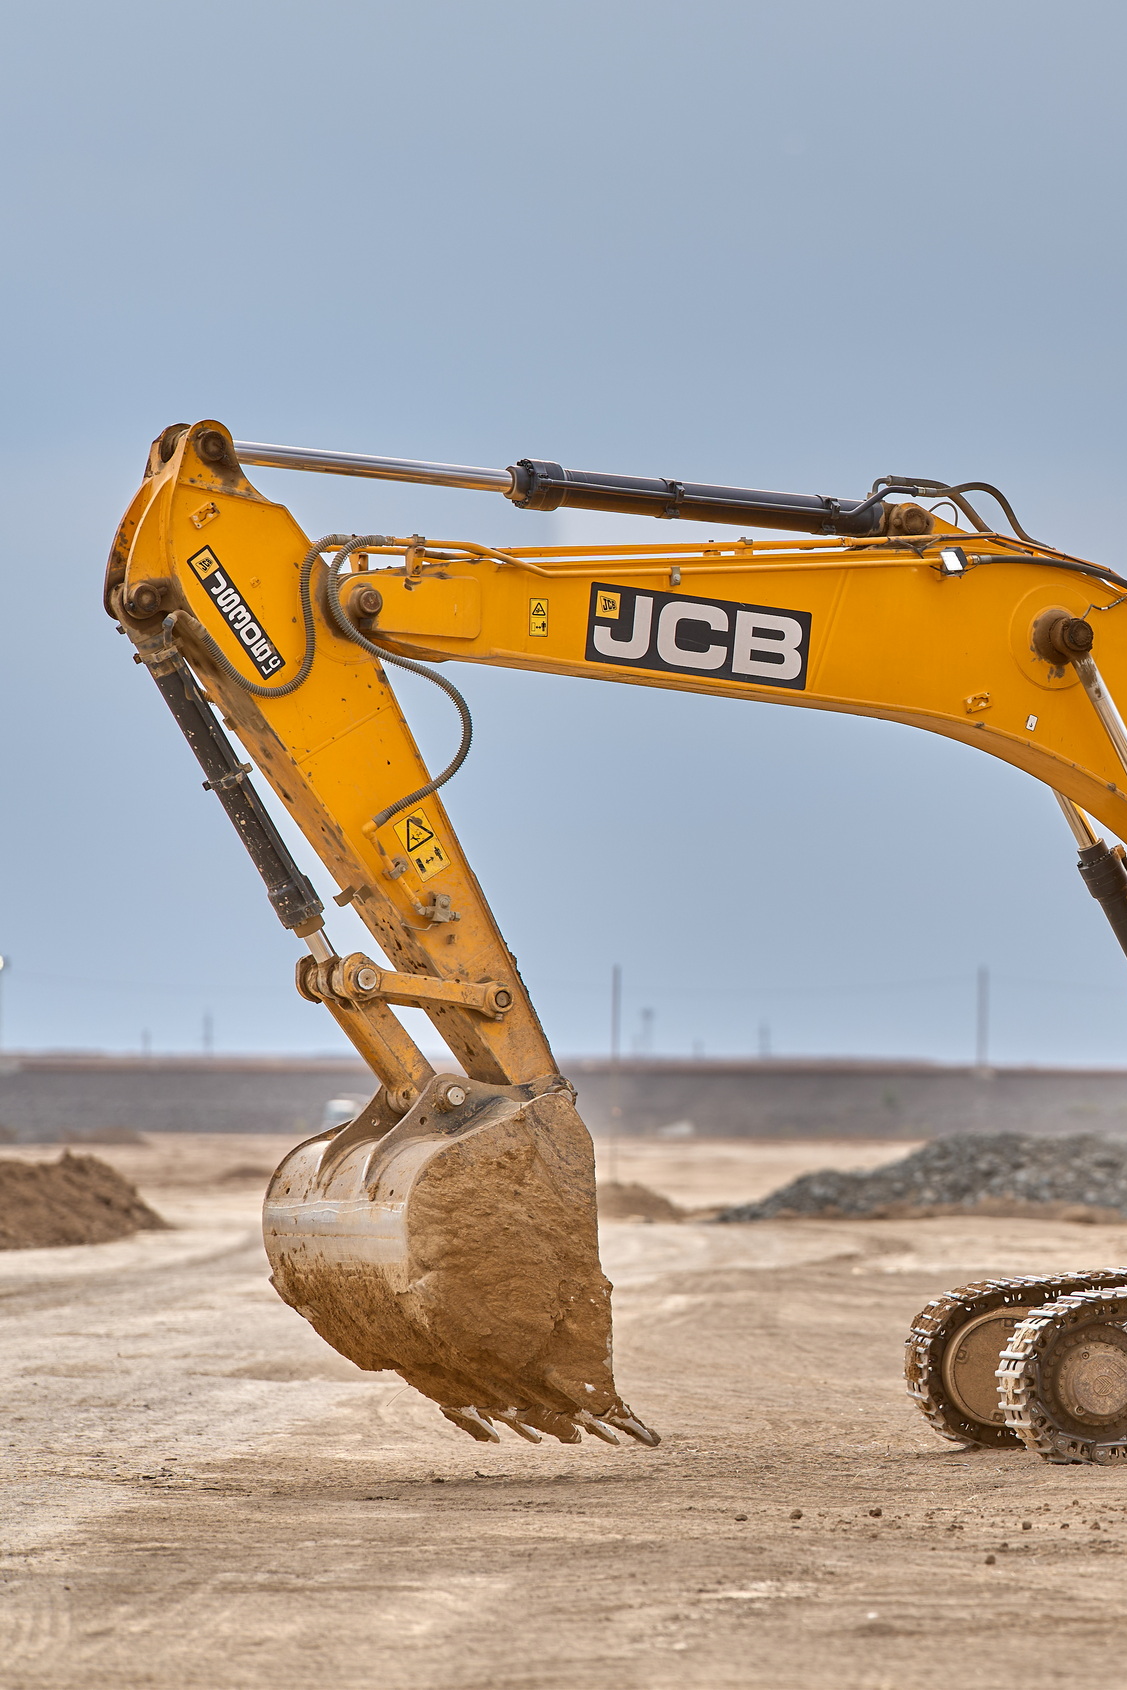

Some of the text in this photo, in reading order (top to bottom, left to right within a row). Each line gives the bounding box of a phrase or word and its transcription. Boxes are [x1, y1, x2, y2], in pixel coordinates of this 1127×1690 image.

[199, 558, 213, 572] JCB
[602, 598, 616, 611] JCB
[593, 595, 803, 680] JCB
